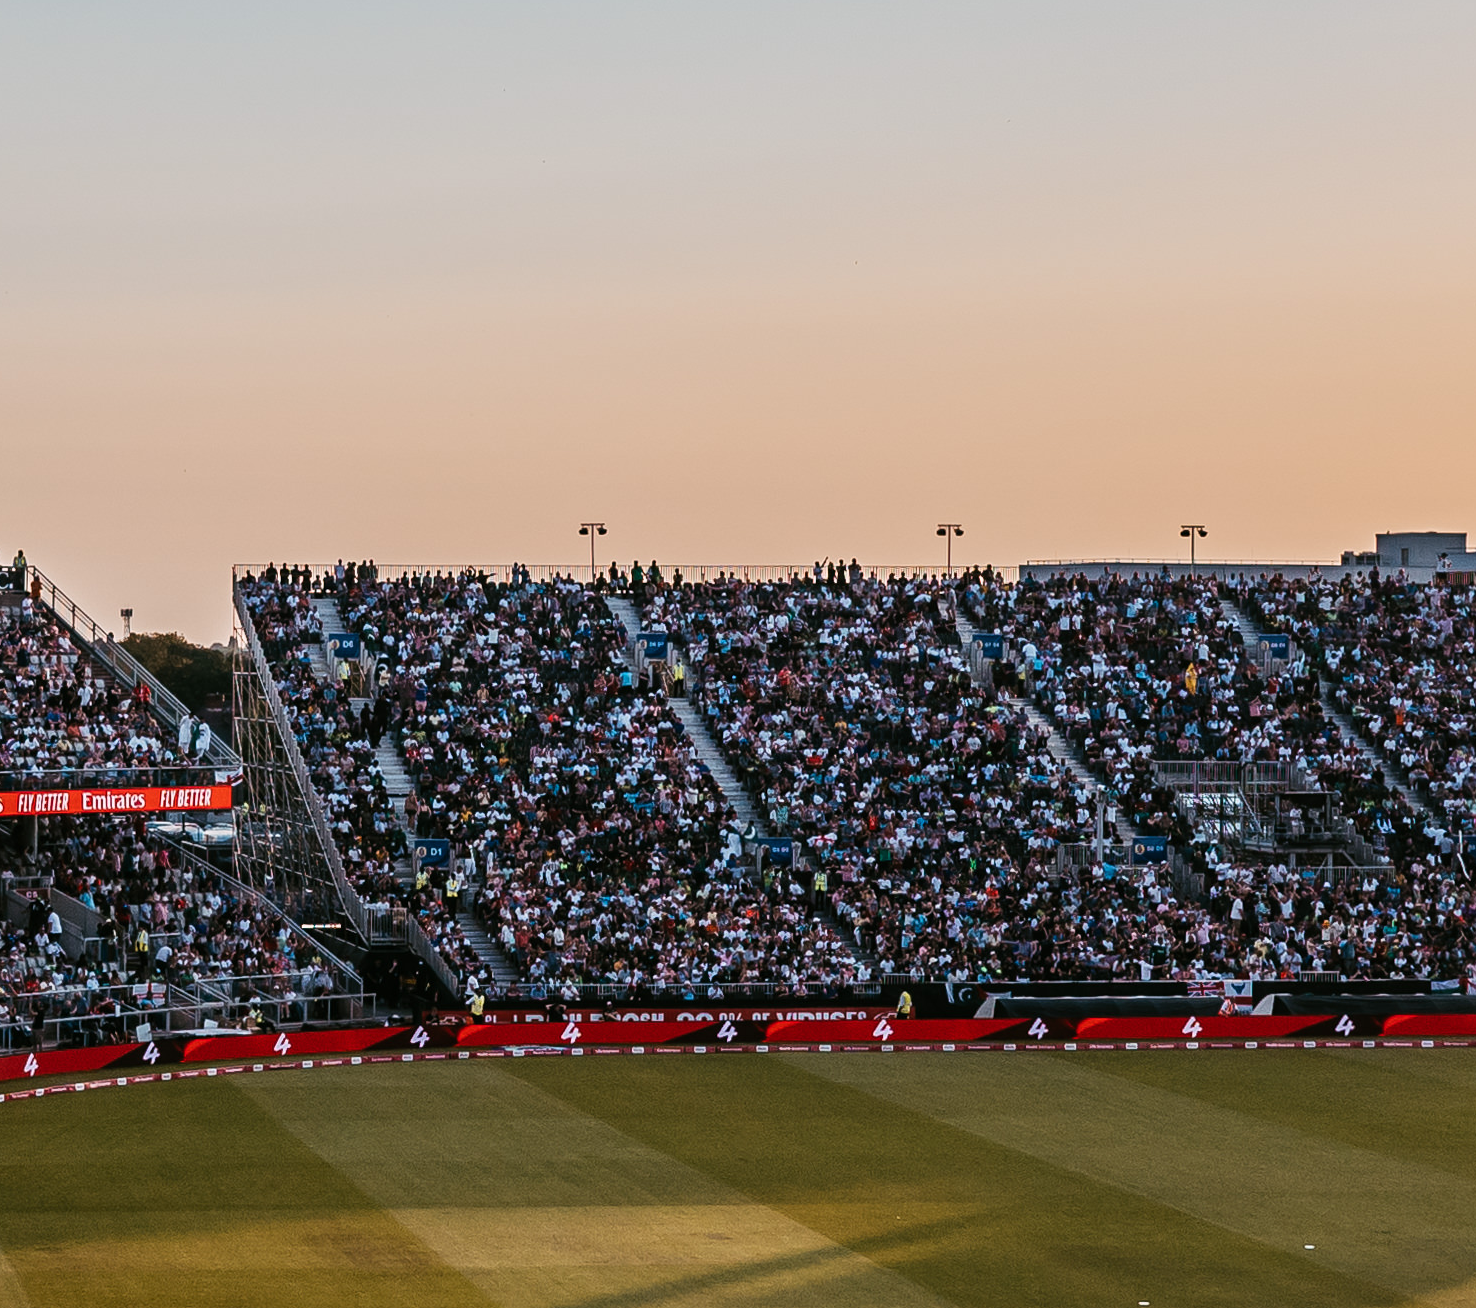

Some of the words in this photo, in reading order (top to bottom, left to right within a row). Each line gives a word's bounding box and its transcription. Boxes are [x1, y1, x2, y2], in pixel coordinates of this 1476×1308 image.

[18, 794, 36, 813] FLY
[35, 792, 69, 812] BETTER
[82, 791, 146, 811] Emirates
[159, 790, 178, 808] FLY
[177, 788, 212, 807] BETTER
[410, 1025, 430, 1048] 4
[560, 1021, 582, 1044] 4
[717, 1020, 738, 1043] 4
[872, 1019, 894, 1041] 4
[1028, 1017, 1049, 1040] 4
[1182, 1016, 1203, 1038] 4
[1335, 1014, 1355, 1036] 4
[142, 1041, 161, 1065] 4
[273, 1032, 292, 1056] 4
[23, 1052, 39, 1077] 4
